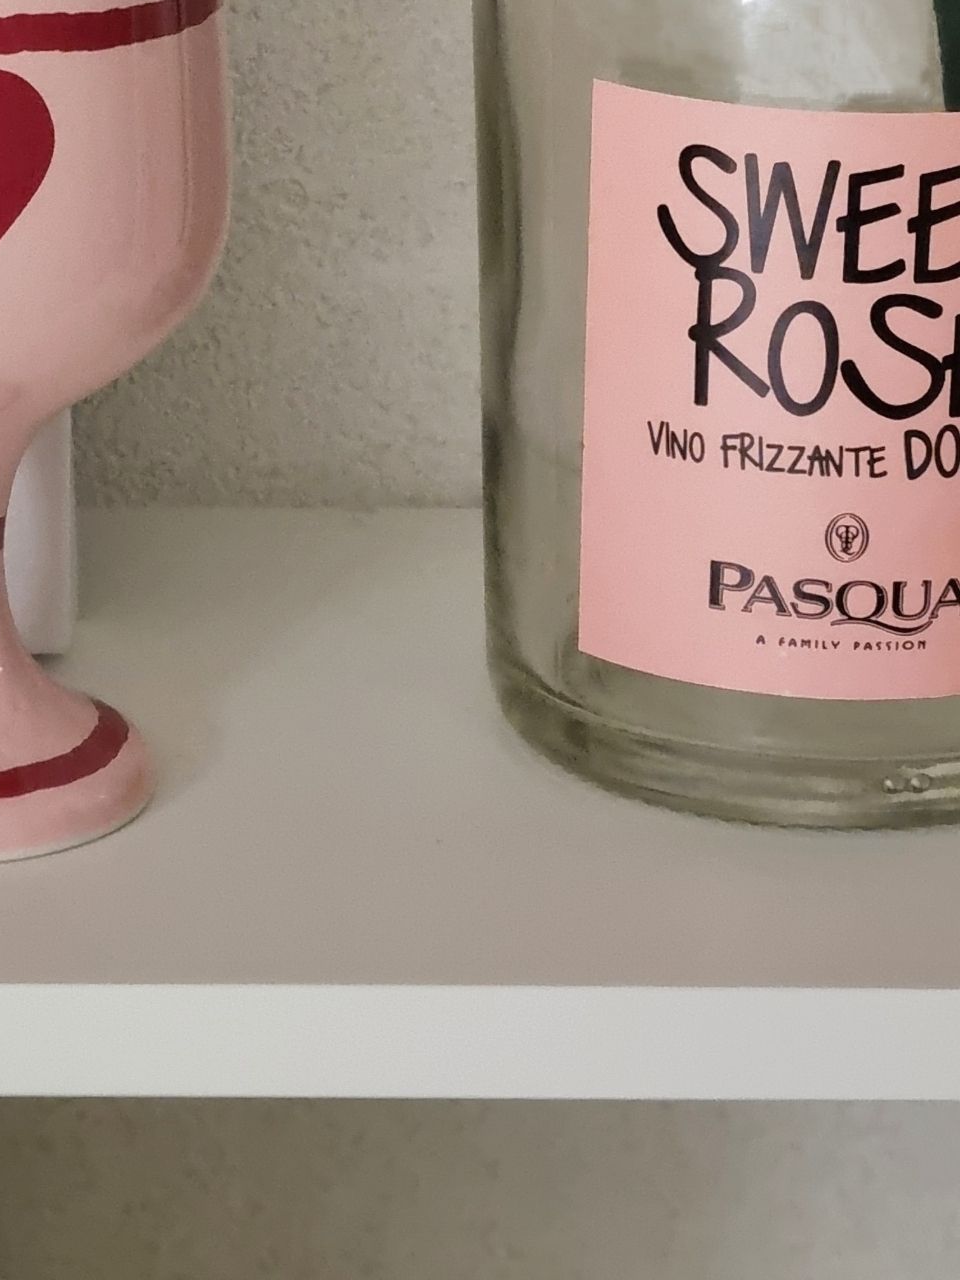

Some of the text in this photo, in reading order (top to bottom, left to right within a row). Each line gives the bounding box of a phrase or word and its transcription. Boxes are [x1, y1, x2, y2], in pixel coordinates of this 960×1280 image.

[687, 265, 960, 421] ROS
[646, 420, 706, 464] VINO
[720, 432, 888, 479] FRIZZANTE
[708, 559, 960, 637] PASQUA
[755, 634, 927, 652] A FAMILY PASSION
